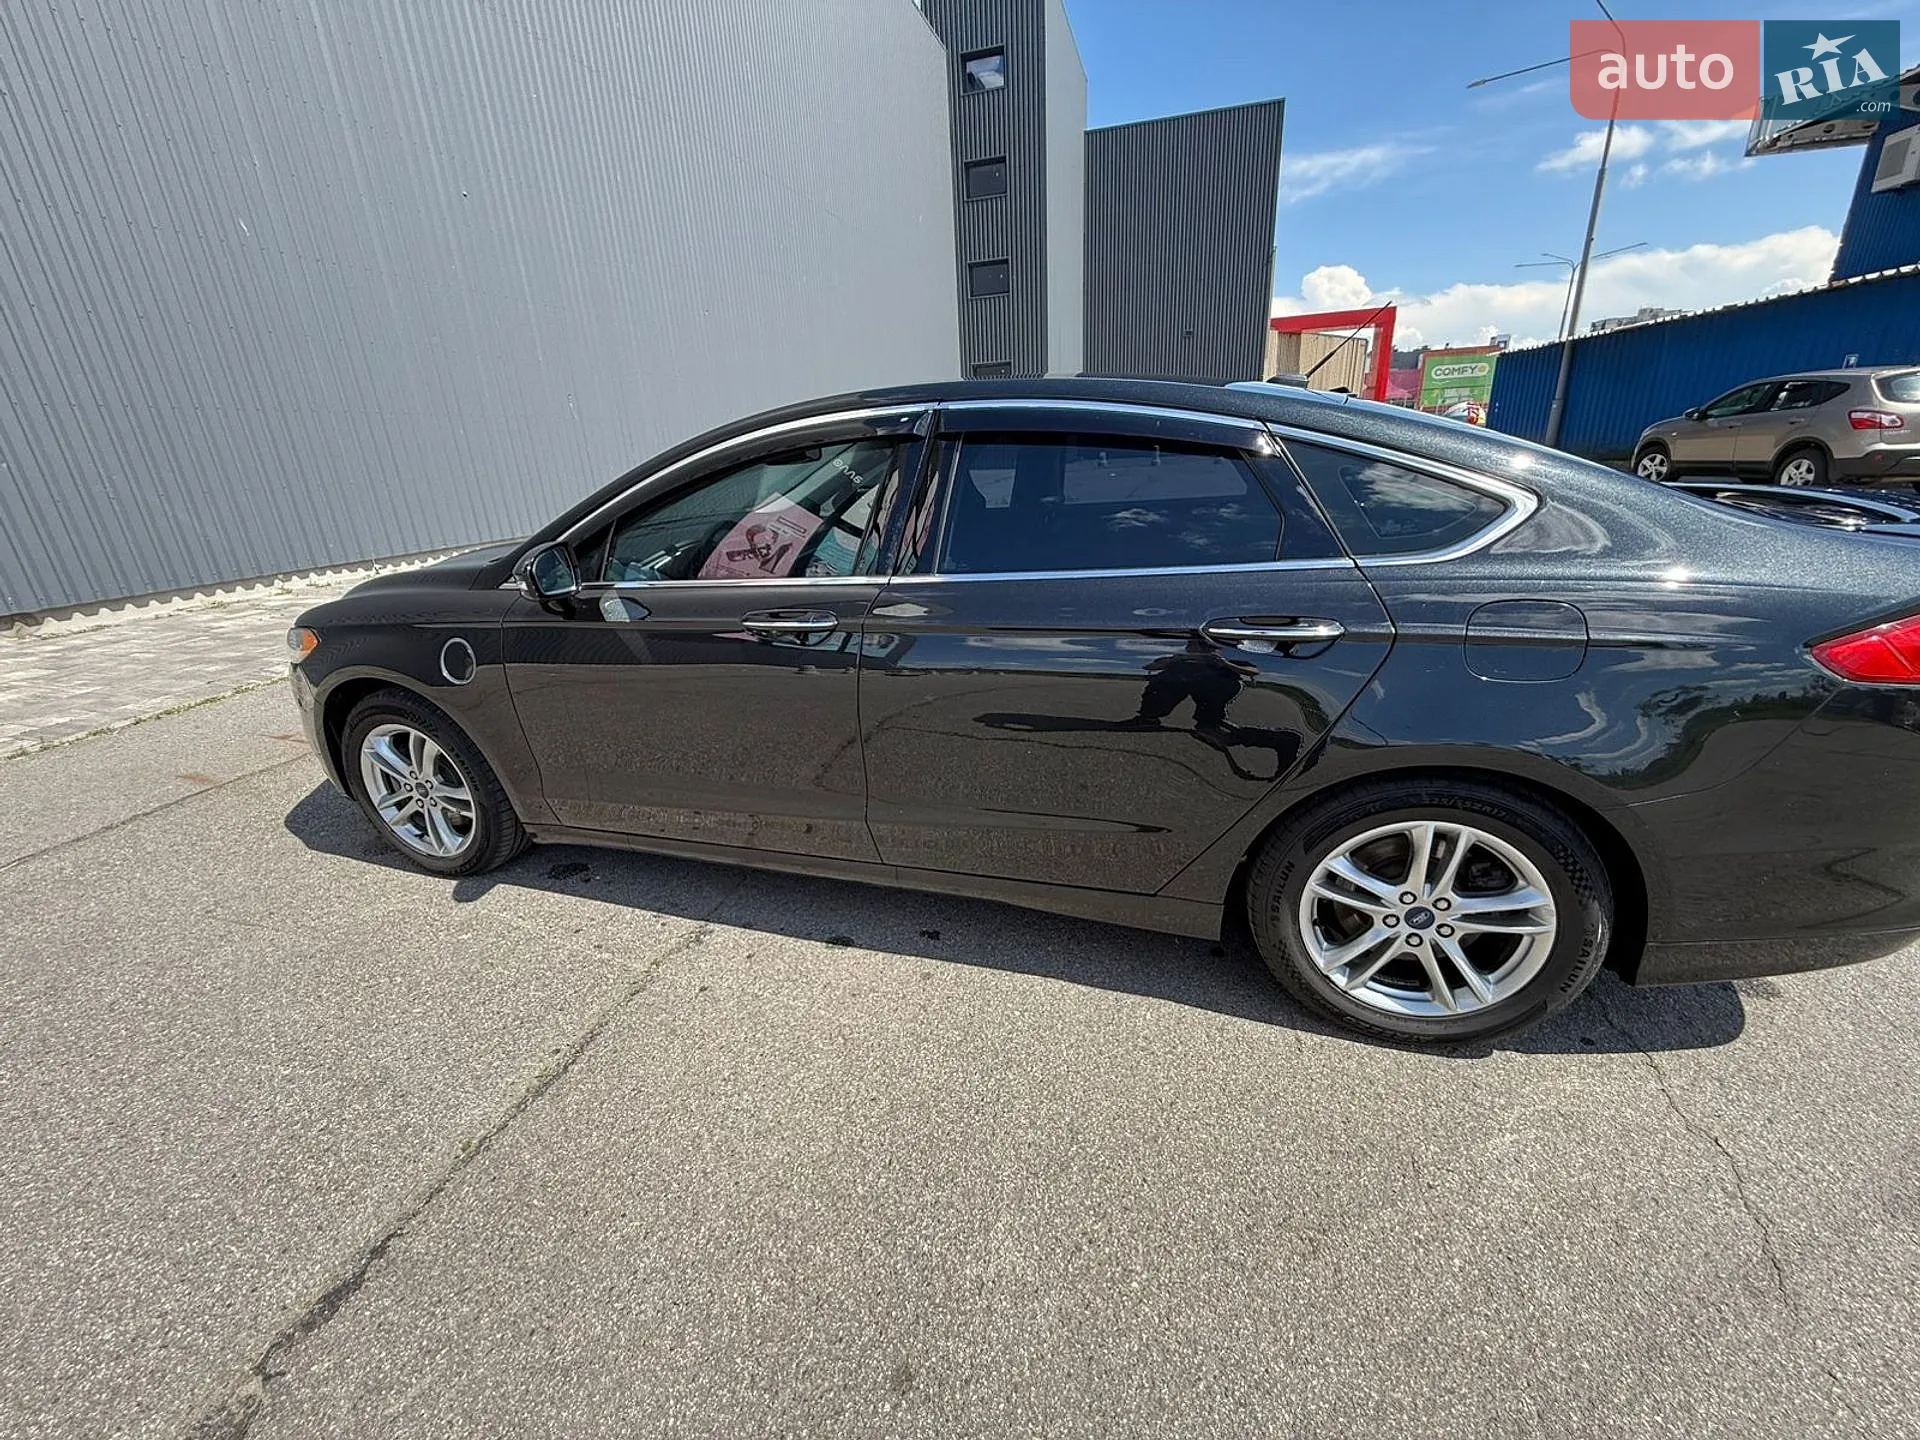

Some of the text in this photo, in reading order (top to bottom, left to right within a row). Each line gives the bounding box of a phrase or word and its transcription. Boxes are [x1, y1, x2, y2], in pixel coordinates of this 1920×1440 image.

[1434, 365, 1478, 377] COMFY
[1270, 860, 1295, 913] SAILUN
[1560, 938, 1594, 993] SAILUN
